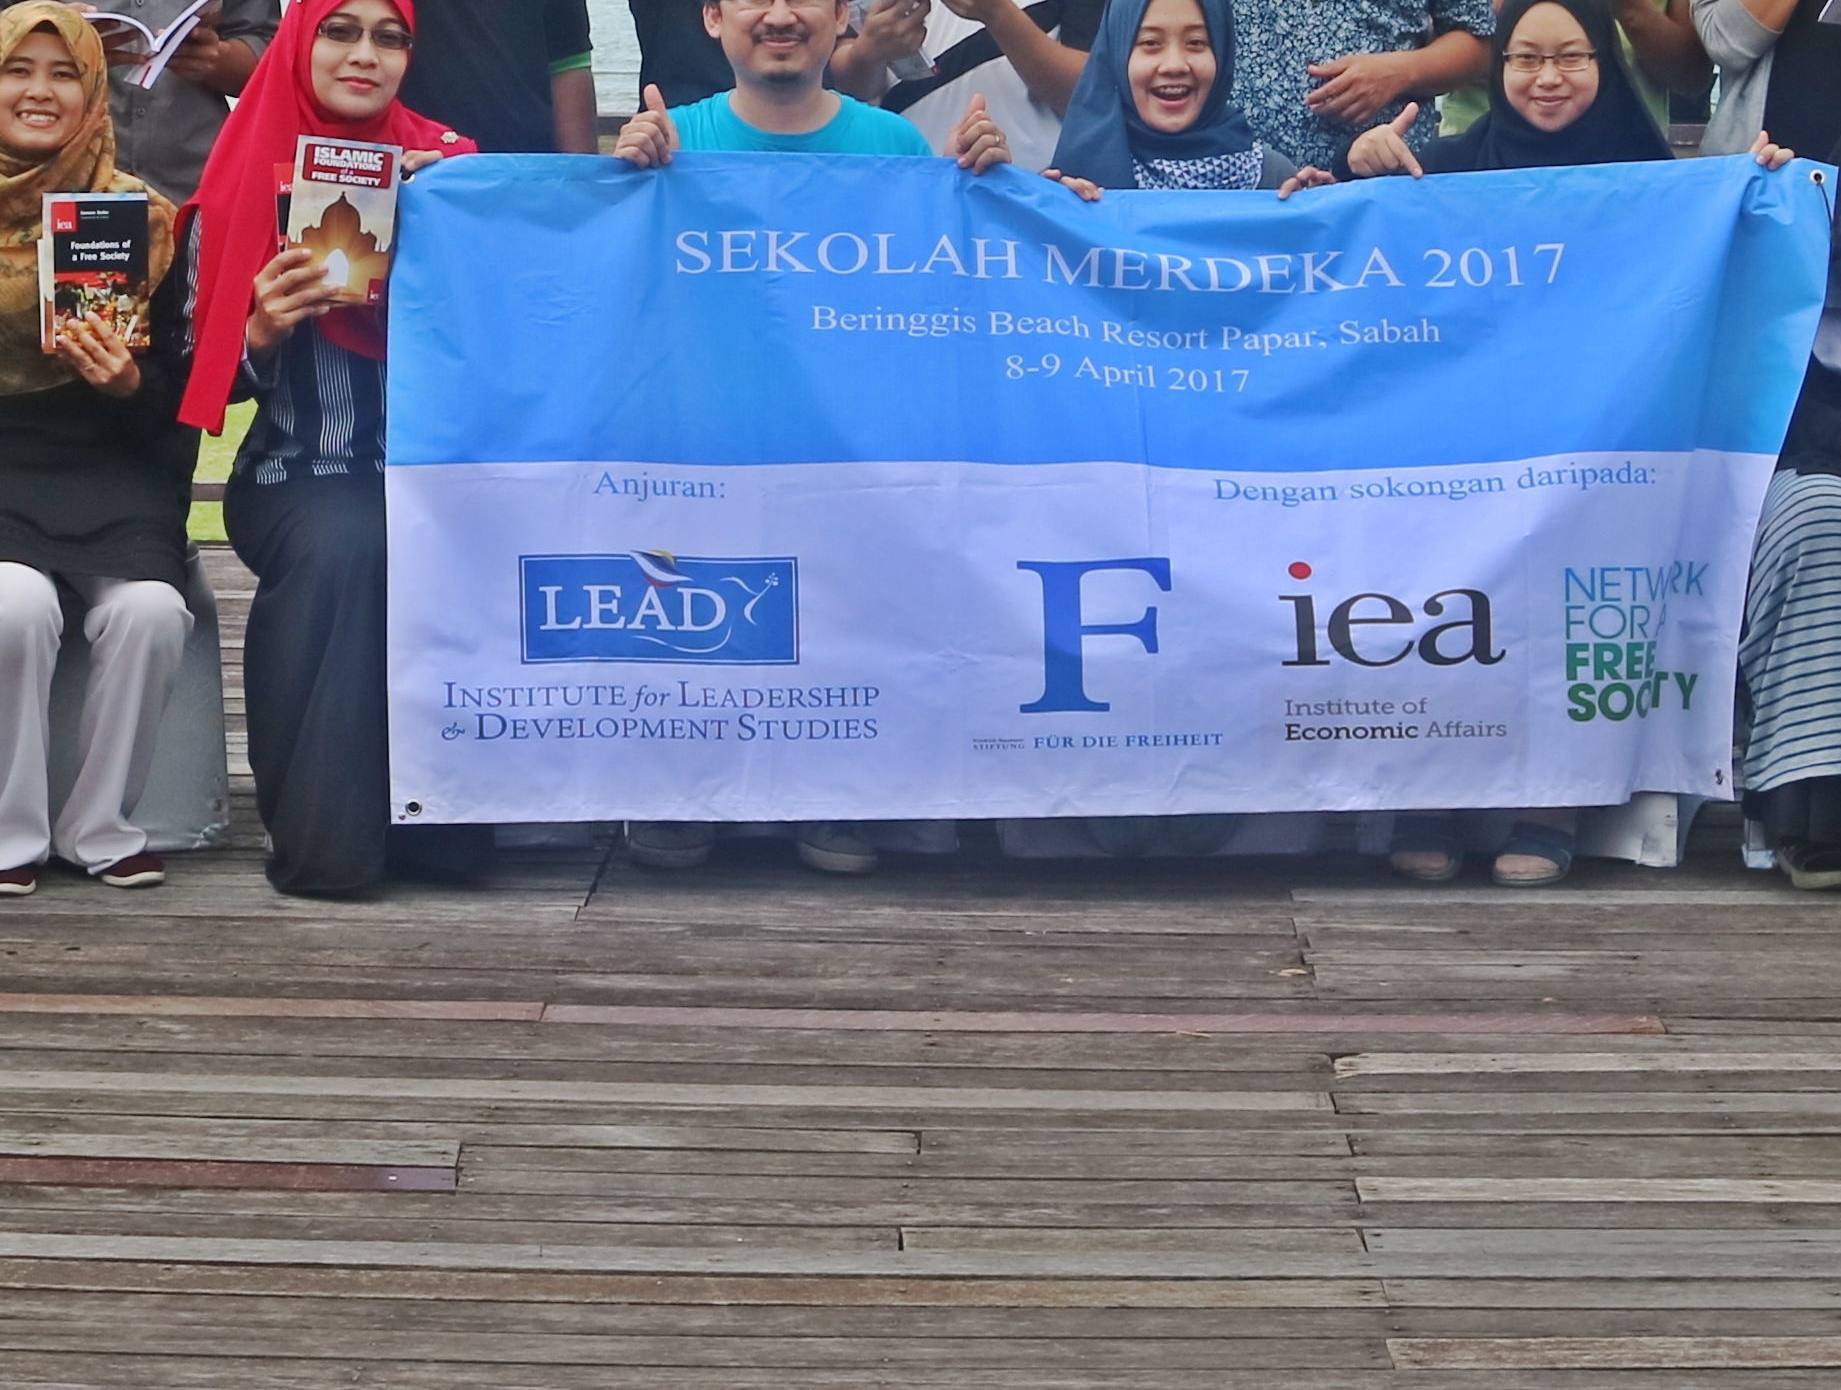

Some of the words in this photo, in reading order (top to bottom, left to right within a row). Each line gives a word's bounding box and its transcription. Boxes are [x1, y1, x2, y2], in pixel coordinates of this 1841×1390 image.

[313, 157, 382, 172] FOUNDATIONS
[314, 146, 384, 165] ISLAMIC
[311, 171, 337, 182] FREE
[339, 174, 382, 186] SOCIETY
[56, 219, 73, 230] iea
[70, 240, 120, 250] Foundations
[121, 239, 131, 249] of
[71, 253, 77, 262] a
[79, 252, 98, 261] Free
[99, 251, 130, 262] Society
[674, 229, 1024, 279] SEKOLAH
[1041, 242, 1407, 295] MERDEKA
[1422, 242, 1565, 289] 2017
[811, 305, 977, 337] Beringgis
[987, 310, 1091, 339] Beach
[1101, 319, 1209, 350] Resort
[1220, 325, 1328, 356] Papar,
[1339, 318, 1441, 345] Sabah
[1005, 352, 1062, 380] 8-9
[1075, 356, 1157, 388] April
[1167, 367, 1250, 394] 2017
[593, 471, 726, 501] Anjuran:
[1213, 477, 1339, 507] Dengan
[1349, 473, 1505, 500] sokongan
[1516, 460, 1657, 491] daripada:
[538, 584, 727, 632] LEAD
[1277, 560, 1508, 667] iea
[1564, 604, 1649, 640] FOR
[1016, 557, 1172, 714] F
[1566, 640, 1658, 681] FREE
[443, 681, 627, 708] INSTITUTE
[632, 683, 670, 713] for
[678, 680, 881, 708] LEADERSHIP
[1283, 697, 1396, 717] Institute
[1401, 696, 1428, 715] of
[474, 713, 729, 741] DEVELOPMENT
[737, 713, 879, 742] STUDIES
[1033, 734, 1075, 749] FÜR
[1081, 735, 1118, 749] DIE
[1124, 732, 1224, 748] FREIHEIT
[1284, 721, 1420, 742] Economic
[1425, 720, 1508, 739] Affairs
